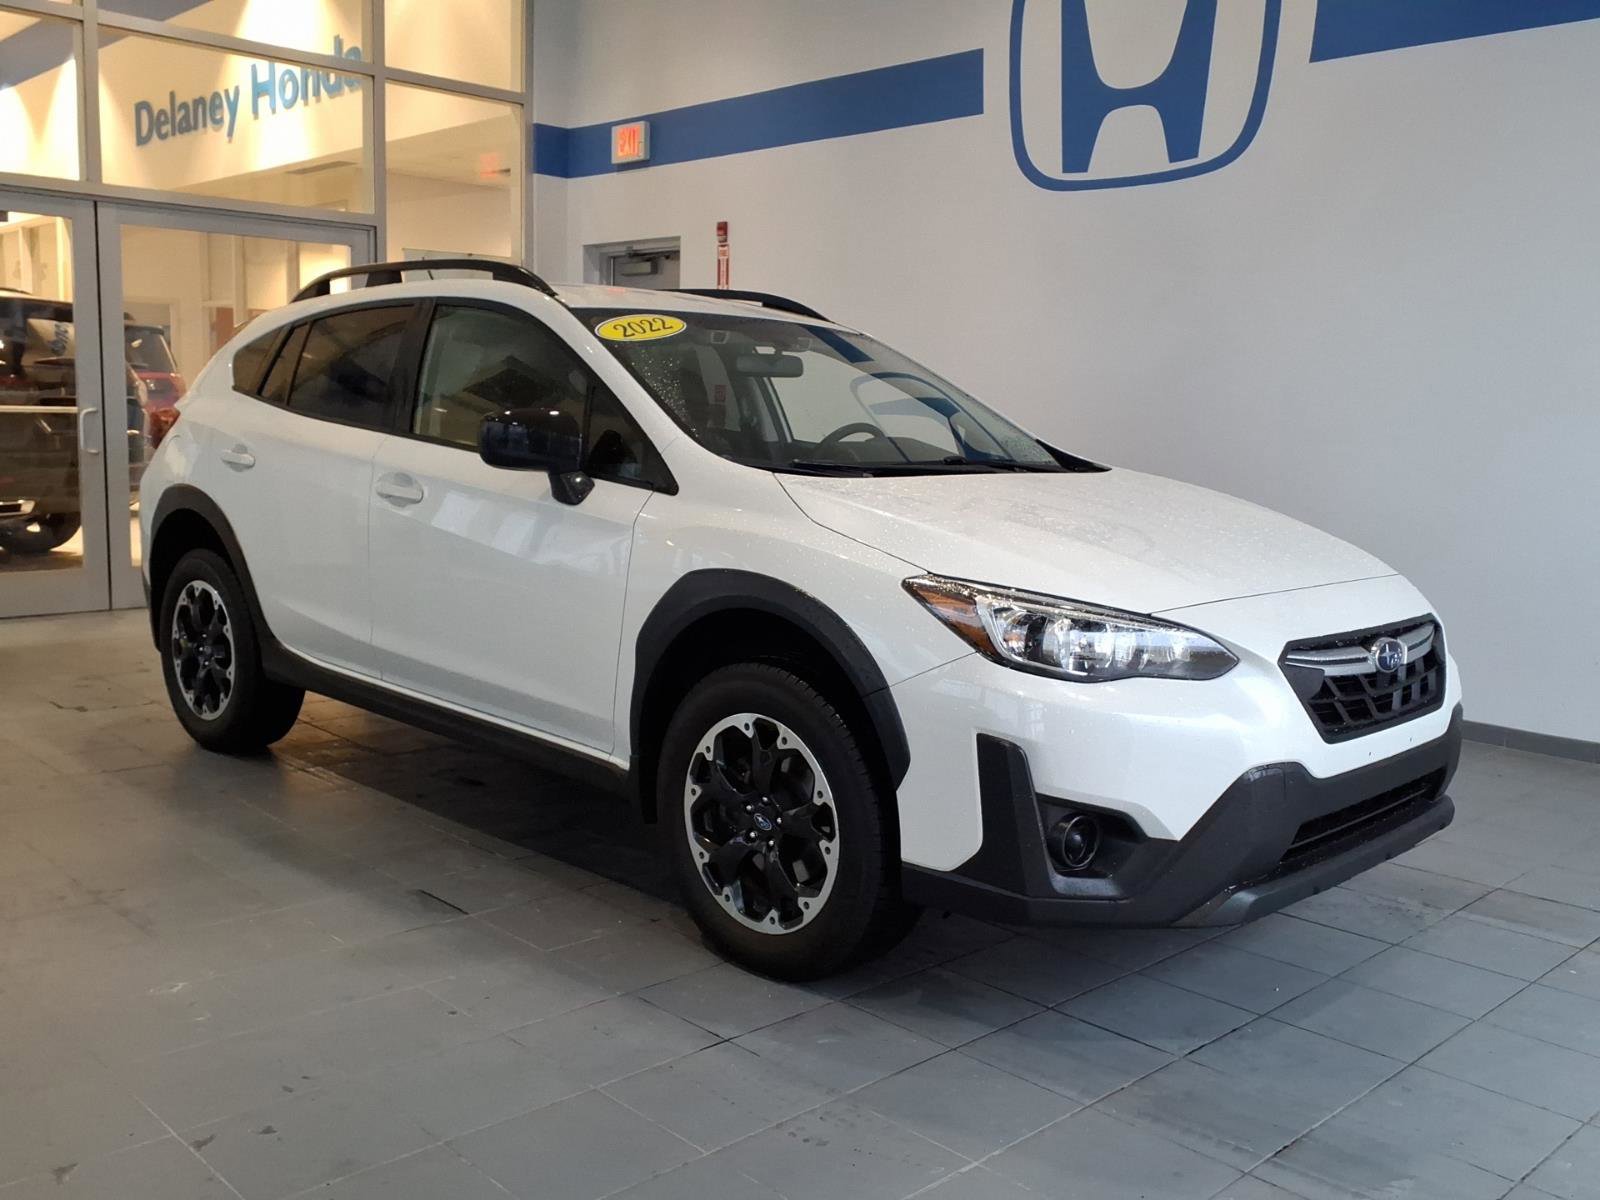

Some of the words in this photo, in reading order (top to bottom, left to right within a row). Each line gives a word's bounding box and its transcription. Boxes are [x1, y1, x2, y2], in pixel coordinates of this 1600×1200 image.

[134, 85, 240, 147] Delaney
[251, 34, 364, 120] Honda
[613, 317, 673, 338] 2022
